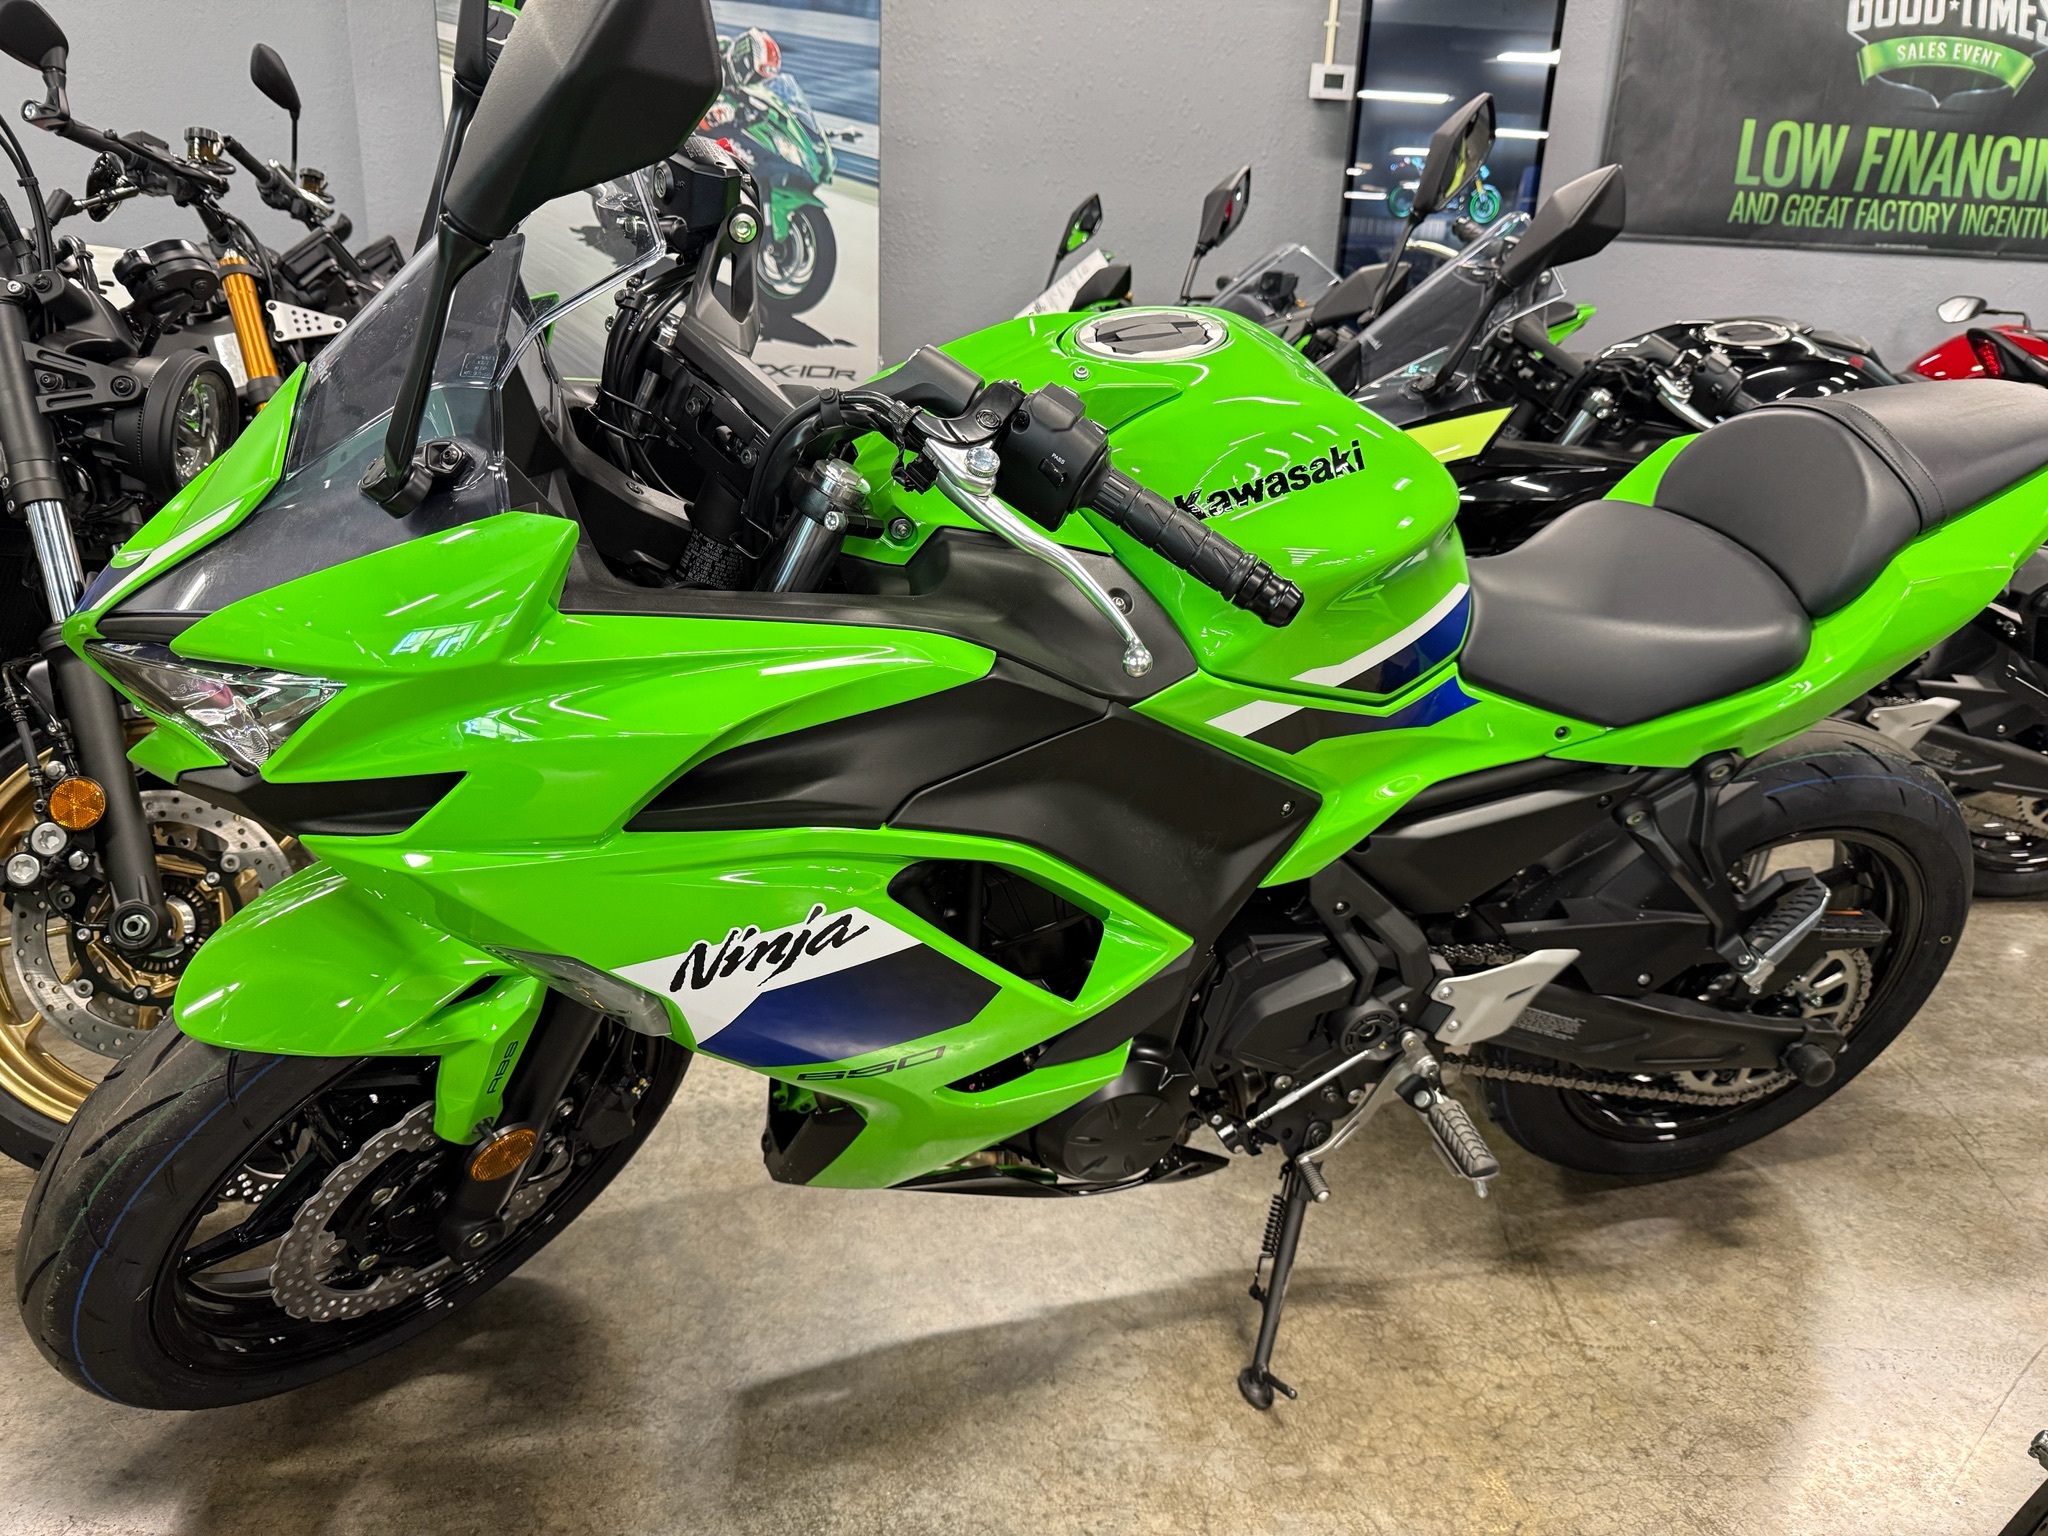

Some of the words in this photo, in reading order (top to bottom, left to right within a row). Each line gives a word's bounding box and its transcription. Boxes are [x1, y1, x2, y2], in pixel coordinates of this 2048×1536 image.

[1897, 41, 1947, 62] SALES
[1953, 43, 2003, 69] EVENT
[1734, 118, 1850, 190] LOW
[1727, 190, 1779, 225] AND
[1781, 193, 1854, 229] GREAT
[1853, 198, 1957, 234] FACTORY
[757, 364, 856, 381] X-10R
[1051, 452, 1066, 465] PASS
[1173, 439, 1366, 521] Kawasaki
[669, 905, 870, 992] Ninja
[487, 1040, 519, 1094] ABS
[797, 1045, 946, 1081] 650
